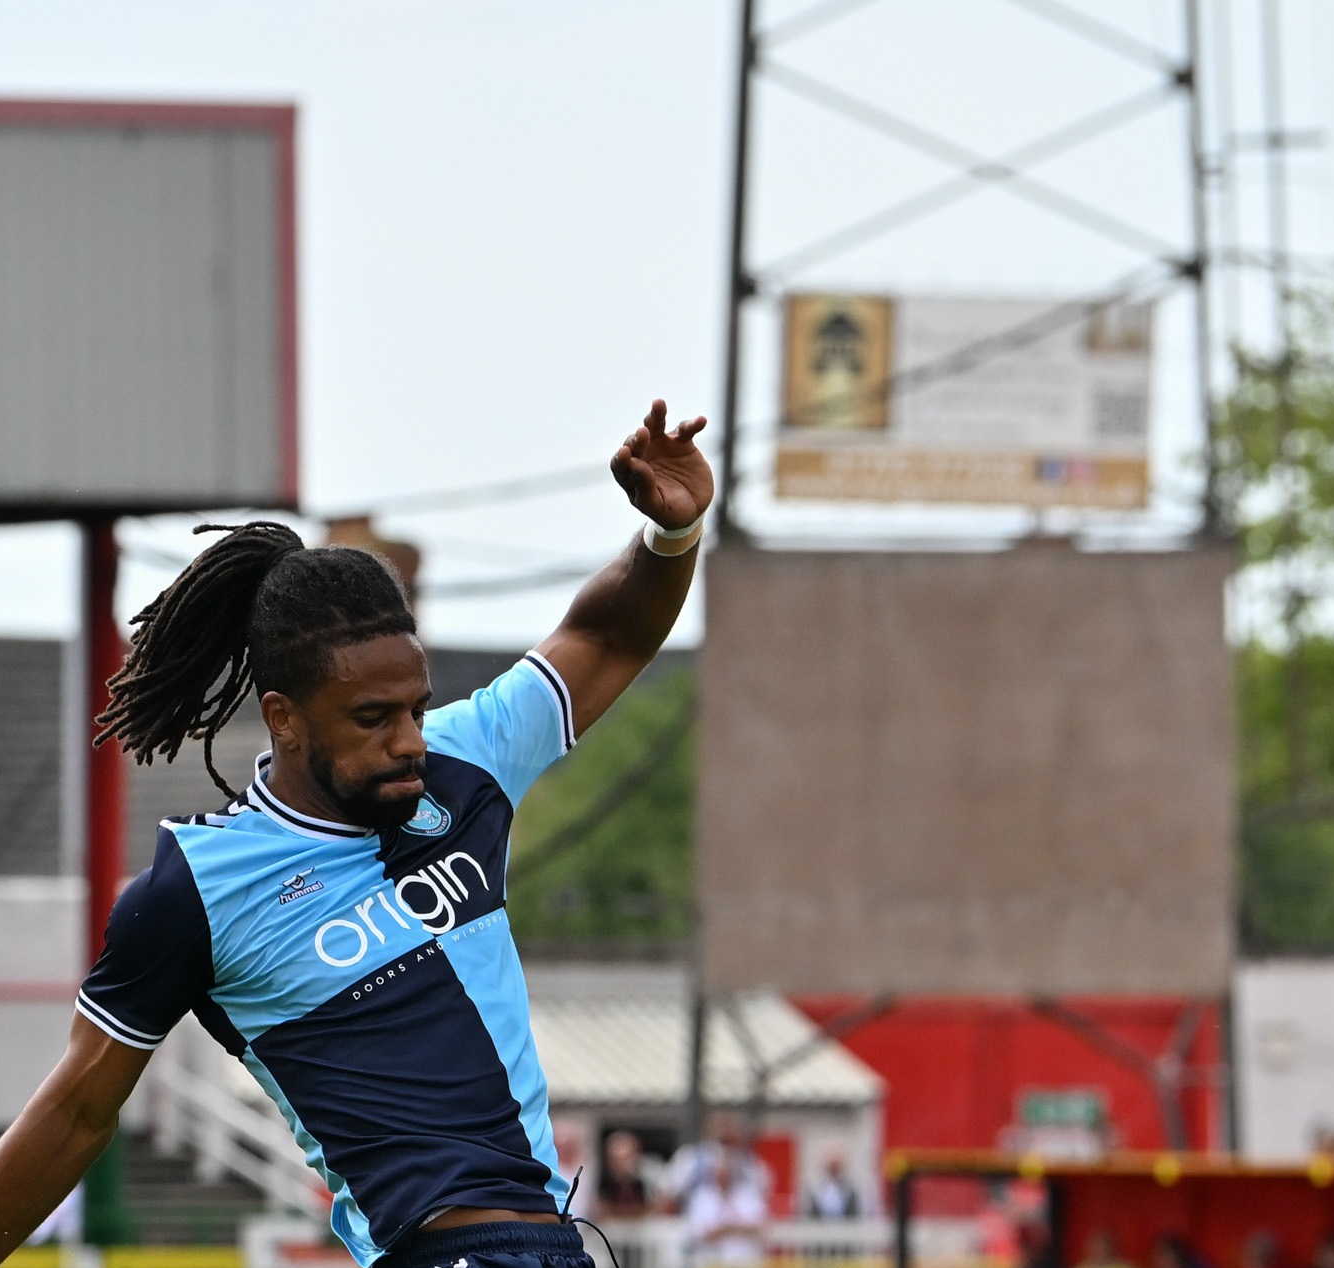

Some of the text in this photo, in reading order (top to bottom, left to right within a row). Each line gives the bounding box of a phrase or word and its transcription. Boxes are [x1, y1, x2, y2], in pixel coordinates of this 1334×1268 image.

[279, 880, 324, 905] hummel
[314, 851, 490, 968] origin
[352, 912, 502, 1001] DOORS AND WINDOWS
